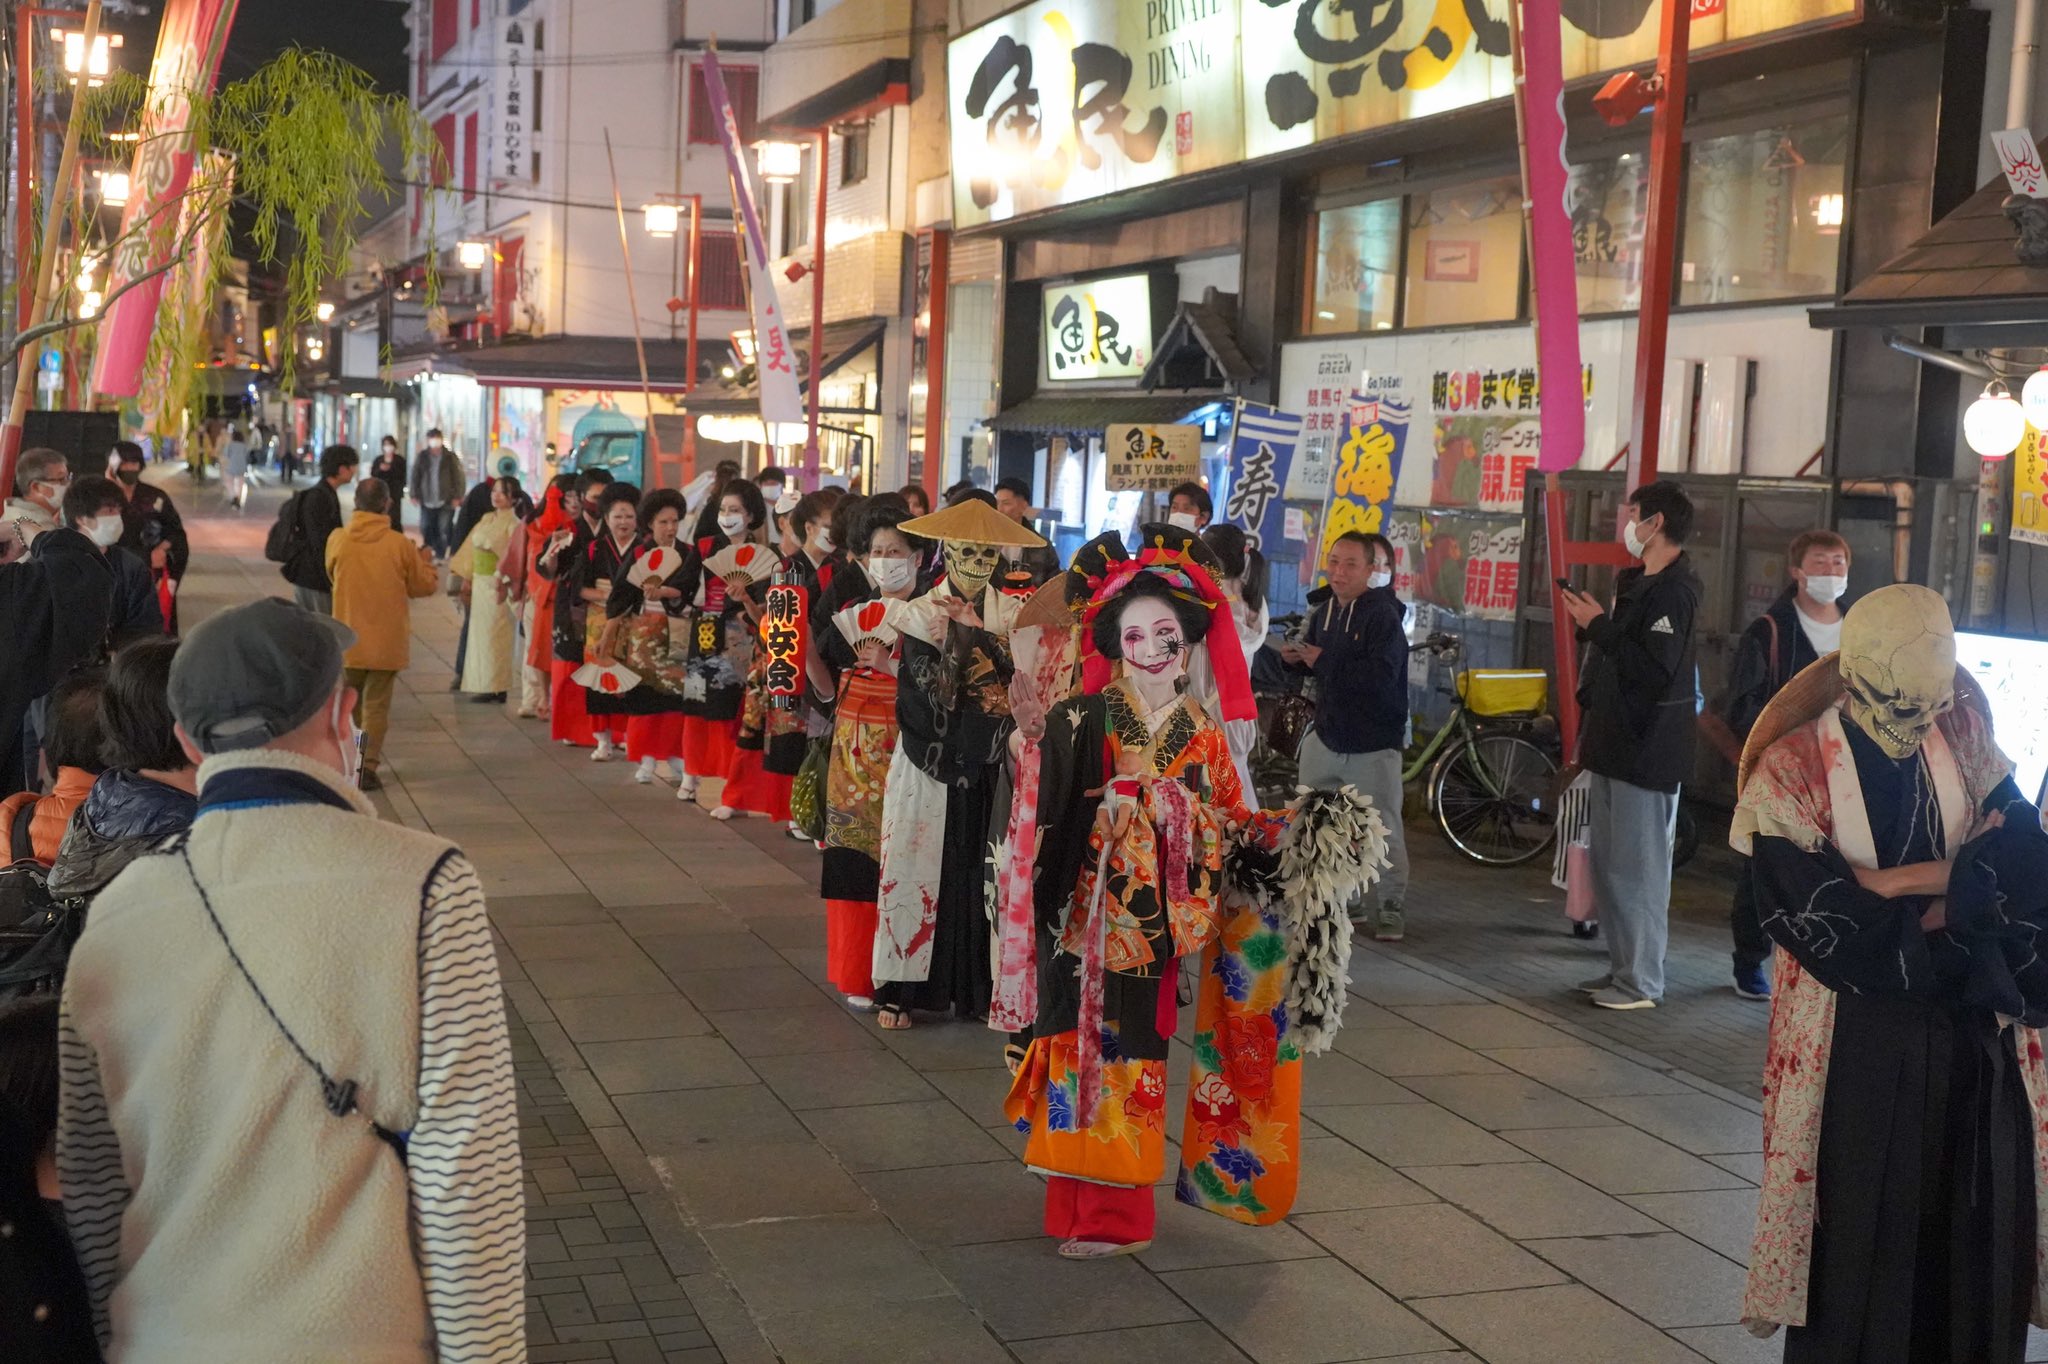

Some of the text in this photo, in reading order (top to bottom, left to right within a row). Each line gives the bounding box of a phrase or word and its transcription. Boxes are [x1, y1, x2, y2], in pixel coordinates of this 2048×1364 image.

[1148, 36, 1211, 91] DINING
[965, 34, 1168, 210] 魚民
[1051, 293, 1132, 370] 魚民
[1318, 353, 1352, 375] GREEN
[1367, 377, 1378, 390] Go
[1125, 426, 1170, 462] 魚民
[1479, 453, 1537, 503] 競馬
[1464, 556, 1520, 611] 競馬
